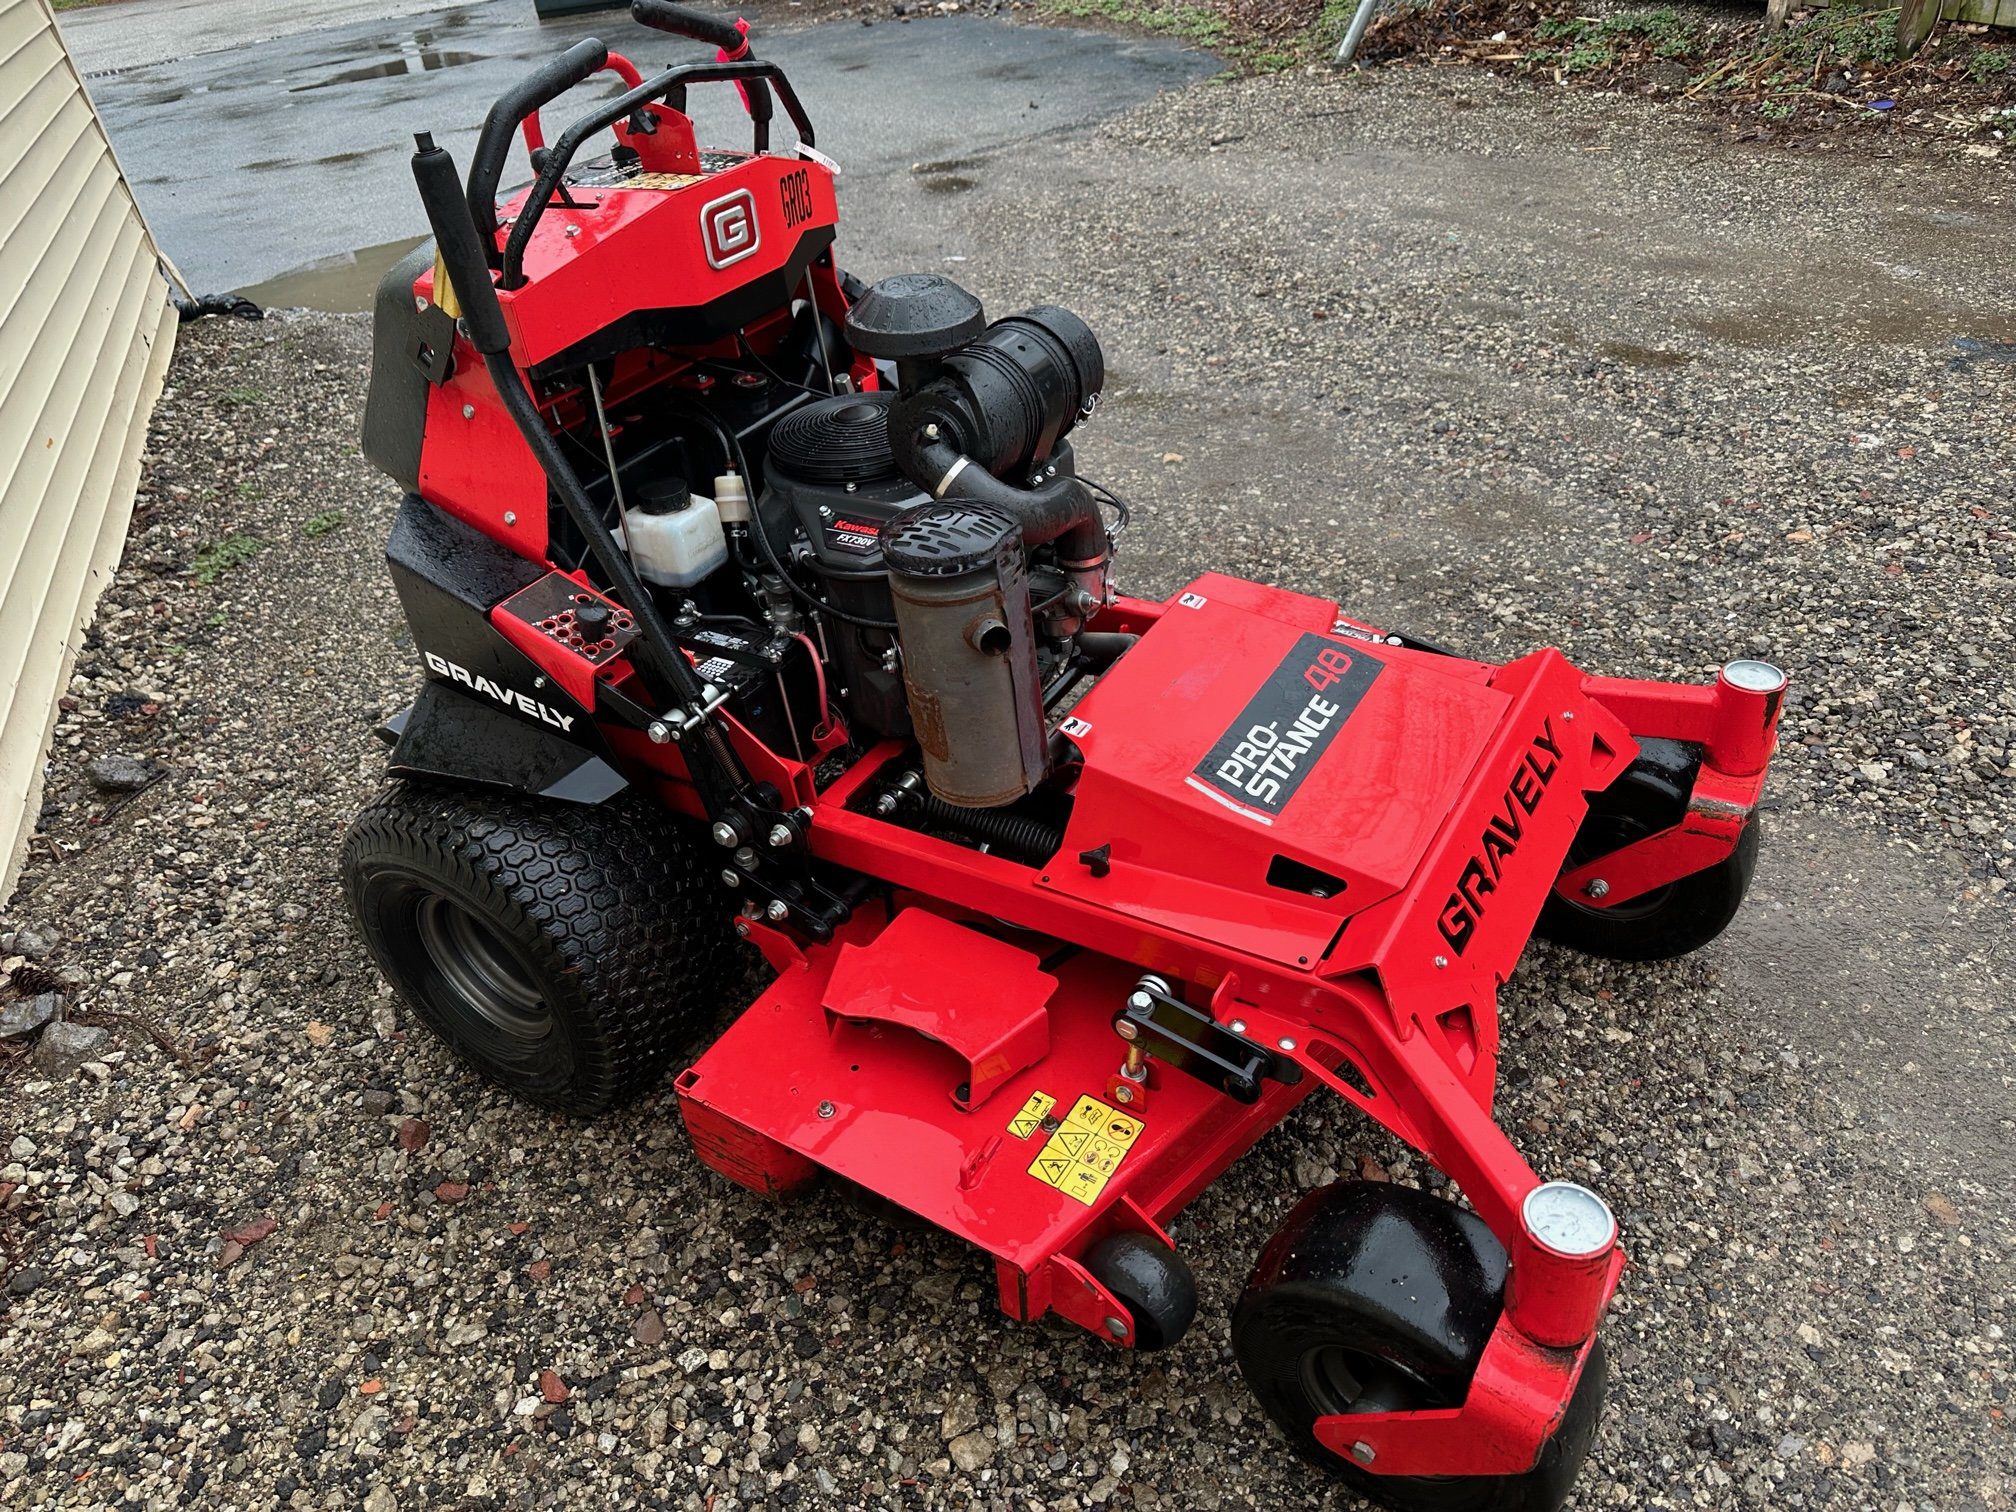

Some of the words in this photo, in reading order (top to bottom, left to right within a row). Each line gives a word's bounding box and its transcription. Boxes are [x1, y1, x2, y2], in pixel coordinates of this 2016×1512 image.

[714, 205, 748, 251] G
[837, 533, 876, 547] FX730V
[424, 651, 575, 732] GRAVELY
[1245, 693, 1340, 804] STANCE
[1304, 648, 1353, 691] 48
[1216, 721, 1278, 788] PRO-
[1437, 715, 1564, 958] GRAVELY
